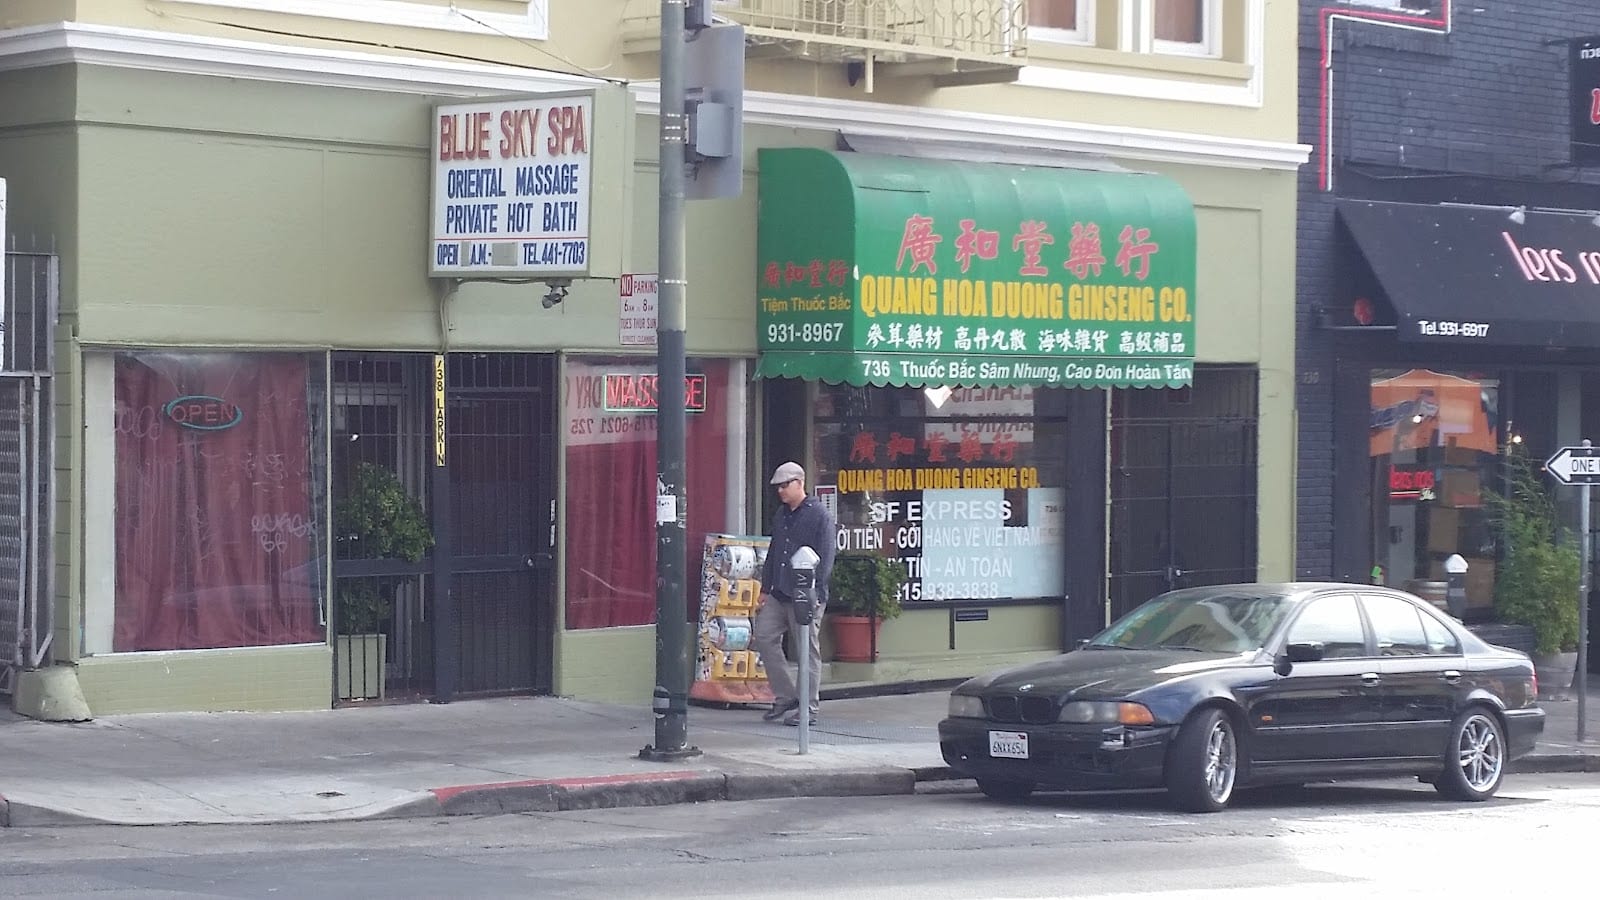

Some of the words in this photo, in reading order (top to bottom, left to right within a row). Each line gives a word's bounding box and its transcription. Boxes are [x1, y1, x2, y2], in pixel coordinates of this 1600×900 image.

[440, 112, 492, 160] BLUE
[500, 108, 541, 158] SKY
[548, 105, 587, 156] SPA
[447, 168, 506, 199] ORIENTAL
[515, 164, 579, 197] MASSAGE
[446, 204, 498, 233] PRIVATE
[507, 203, 533, 232] HOT
[543, 201, 578, 232] BATH
[437, 243, 459, 265] OPEN
[896, 213, 1159, 280] 廣和堂藥行
[622, 275, 632, 295] NO
[634, 280, 657, 294] PARKING
[761, 297, 788, 316] Tiệm
[791, 294, 825, 312] Thuốc
[829, 292, 851, 311] Bắc
[861, 275, 937, 318] QUANG
[943, 279, 987, 316] HOA
[992, 281, 1063, 320] DUONG
[1068, 284, 1155, 322] GINSENG
[1159, 287, 1192, 322] CO.
[768, 322, 844, 343] 931-8967
[862, 360, 890, 377] 736
[900, 359, 945, 378] Thuốc
[949, 358, 975, 378] Bắc
[979, 361, 1009, 379] Sâm
[1012, 363, 1060, 382] Nhung,
[1065, 363, 1092, 379] Cao
[1095, 363, 1122, 379] Đơn
[1125, 363, 1160, 379] Hoàn
[607, 377, 702, 407] MASSE
[172, 403, 234, 422] OPEN
[1571, 459, 1594, 472] ONE
[838, 469, 883, 494] QUANG
[886, 468, 914, 490] HOA
[915, 467, 960, 489] DUONG
[963, 467, 1018, 489] GINSENG
[1020, 466, 1040, 488] CO.
[872, 501, 900, 522] SF
[907, 500, 1012, 521] EXPRESS
[1014, 526, 1040, 547] NAM
[944, 556, 965, 577] AN
